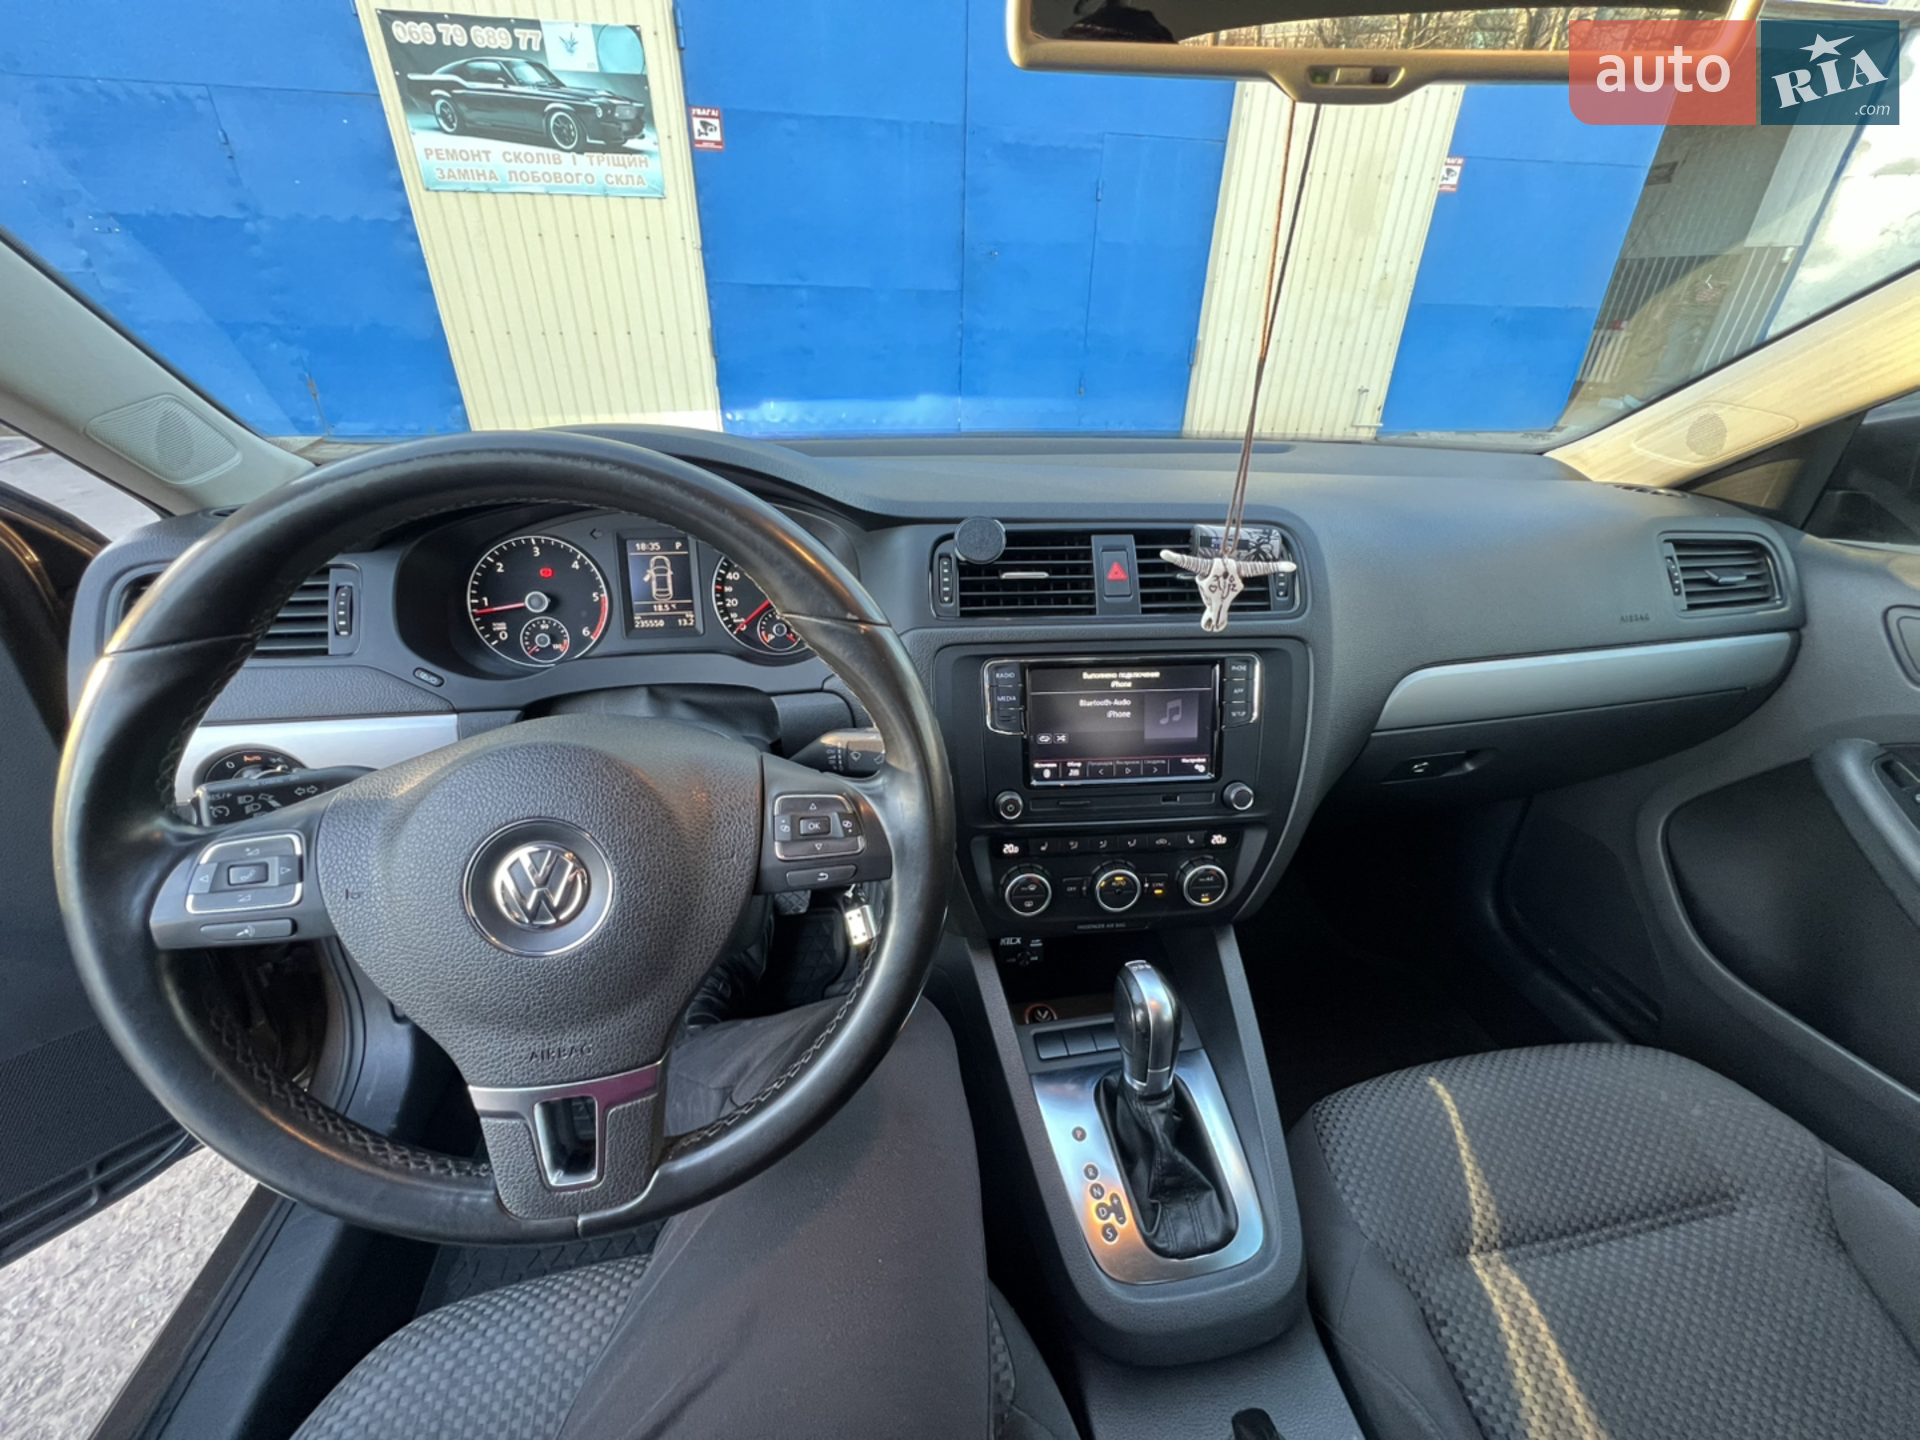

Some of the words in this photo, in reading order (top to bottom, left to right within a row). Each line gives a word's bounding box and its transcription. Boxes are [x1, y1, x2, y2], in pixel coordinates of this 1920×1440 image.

[391, 20, 436, 45] 066
[436, 23, 468, 47] 79
[470, 25, 512, 50] 689
[513, 28, 542, 51] 77
[423, 147, 492, 163] РЕМОНТ
[502, 150, 563, 166] СКОЛІВ
[585, 154, 649, 170] ТРІЩИН
[435, 167, 499, 182] ЗАМІНА
[507, 170, 596, 185] ЛОБОВОГО
[604, 173, 646, 187] СКЛА
[635, 543, 661, 551] 18:35
[675, 541, 682, 550] P
[533, 546, 540, 557] 3
[496, 562, 505, 573] 2
[571, 560, 580, 570] 4
[725, 571, 740, 581] 40
[481, 596, 489, 607] 1
[592, 592, 600, 602] 5
[725, 598, 739, 608] 20
[499, 630, 508, 641] 0
[582, 626, 591, 637] 6
[1110, 680, 1133, 688] iPhone
[1106, 710, 1131, 718] iPhone
[808, 822, 820, 831] OK
[529, 1043, 594, 1063] AIRBAG
[1087, 1167, 1095, 1177] R
[1092, 1187, 1101, 1197] N
[1099, 1207, 1108, 1217] D
[1106, 1228, 1113, 1239] S
